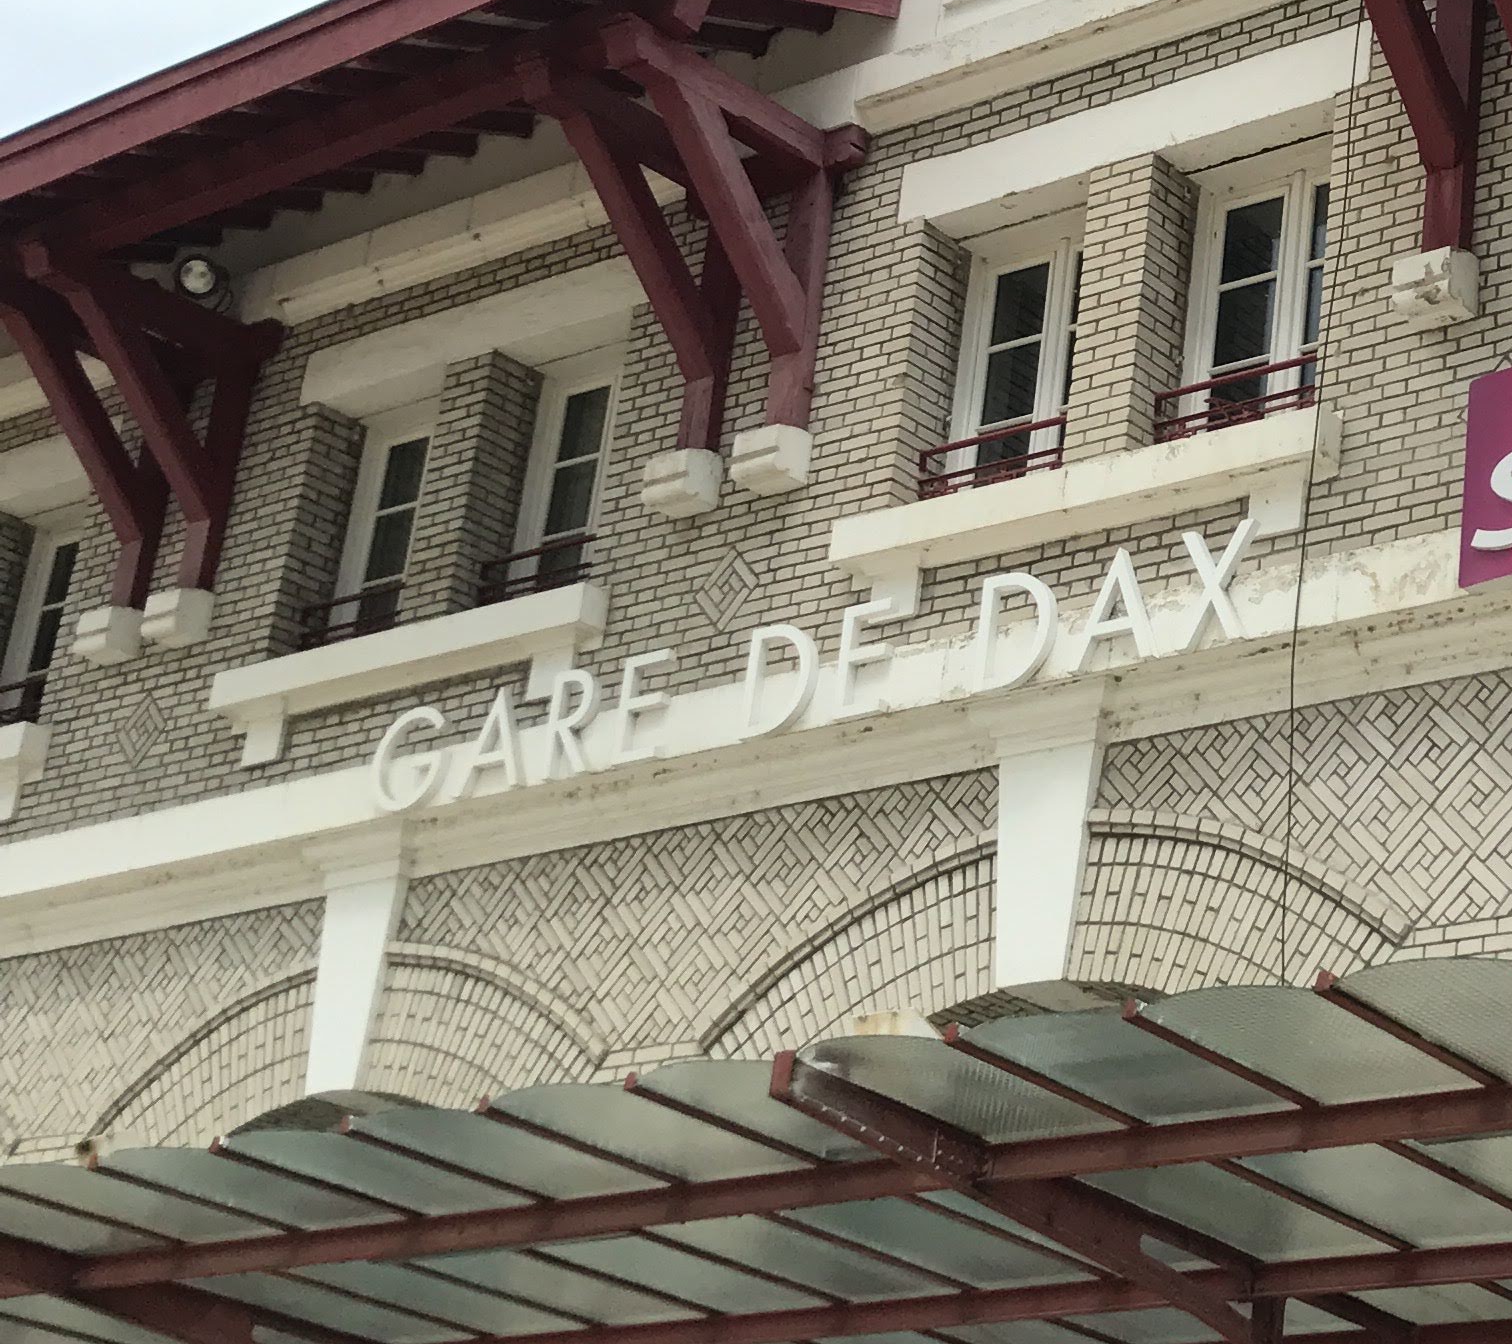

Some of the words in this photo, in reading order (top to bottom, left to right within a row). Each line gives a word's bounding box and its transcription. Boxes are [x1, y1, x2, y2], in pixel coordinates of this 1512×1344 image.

[374, 648, 677, 812] GARE
[740, 597, 910, 737] DE
[978, 516, 1261, 692] DAX
